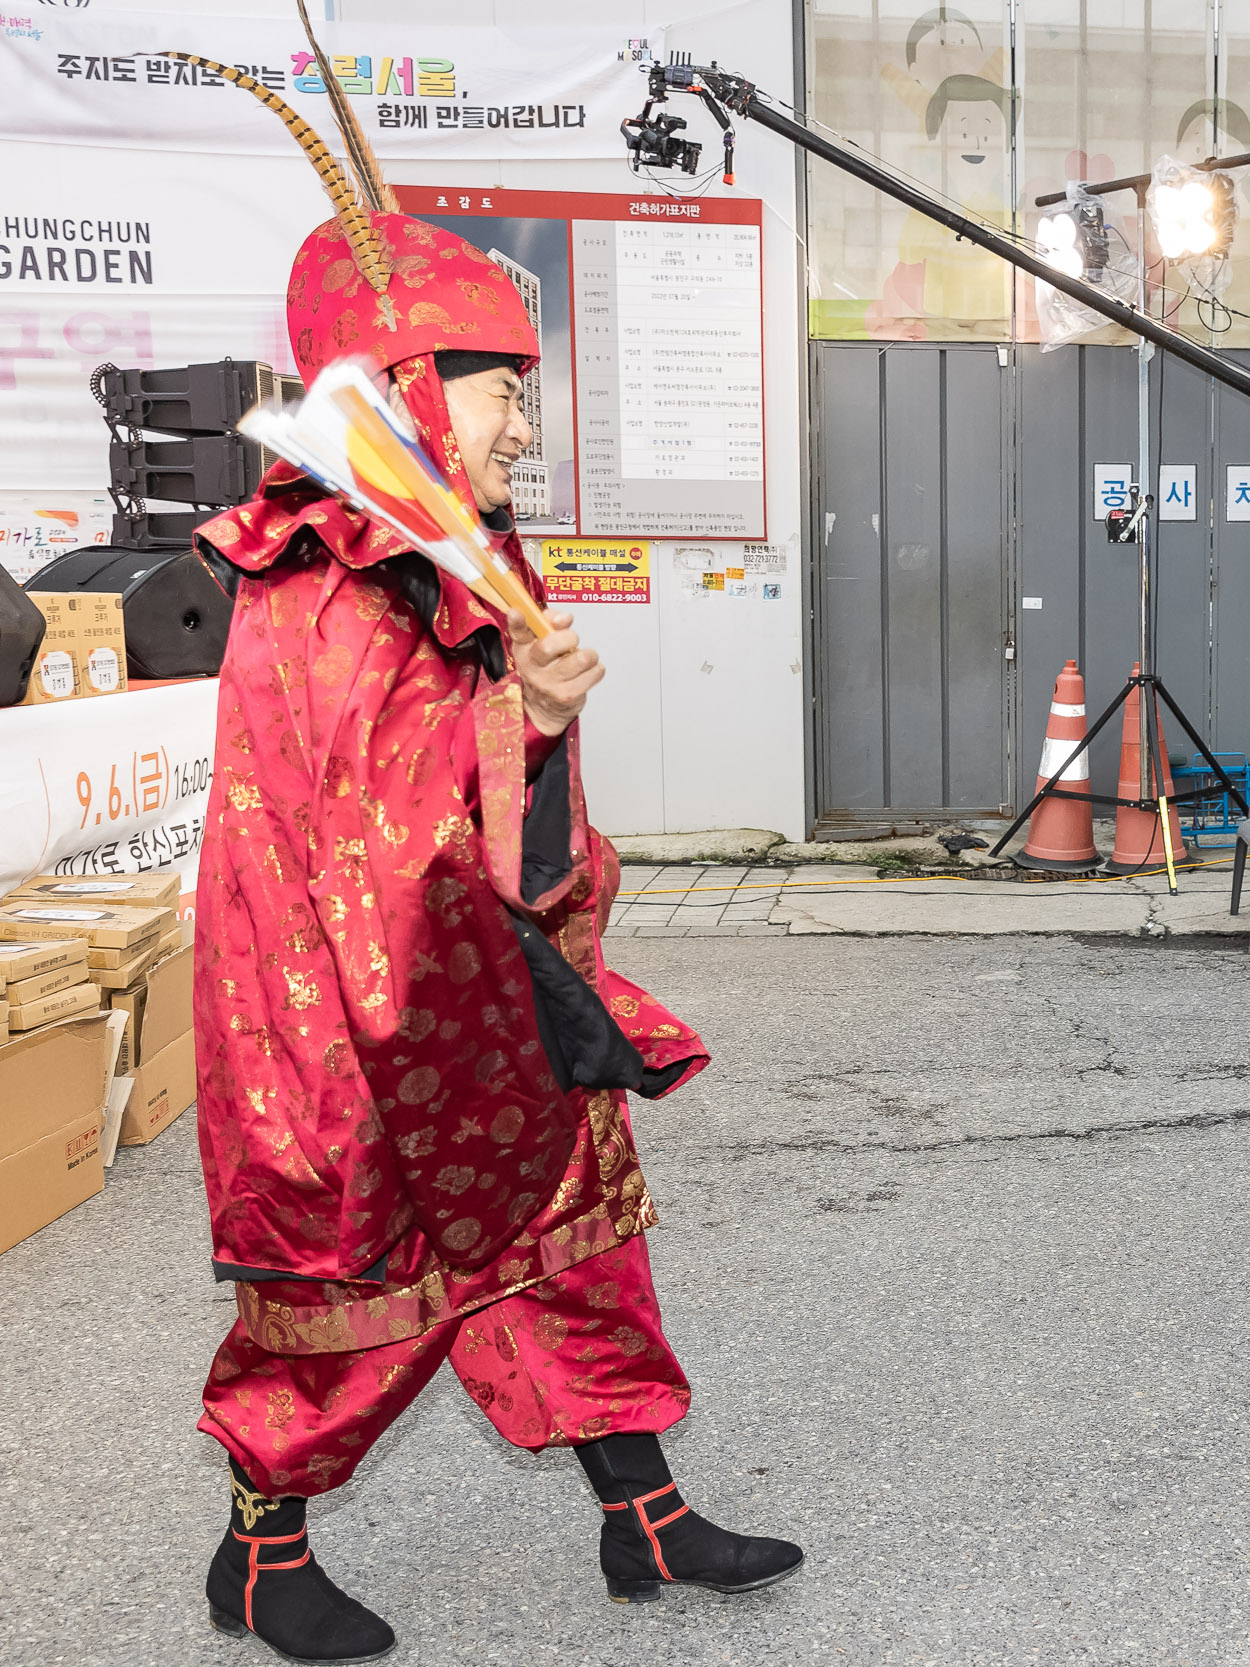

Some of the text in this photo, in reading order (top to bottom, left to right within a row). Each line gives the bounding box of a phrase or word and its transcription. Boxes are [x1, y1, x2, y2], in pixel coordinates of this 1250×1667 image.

[58, 54, 137, 82] 주지도
[146, 59, 225, 87] 받지도
[377, 103, 586, 129] 함께 만들어갑니다
[629, 202, 701, 217] 건축허가표지판
[0, 216, 150, 244] HUNGCHUN
[549, 546, 626, 558] kt 통신케이블 매설
[546, 576, 648, 592] 무단굴착 절대금지
[547, 593, 558, 601] kt
[582, 593, 648, 602] 010-6822-9003
[31, 930, 40, 938] IH
[67, 1158, 80, 1171] Made
[85, 1147, 99, 1160] Korea
